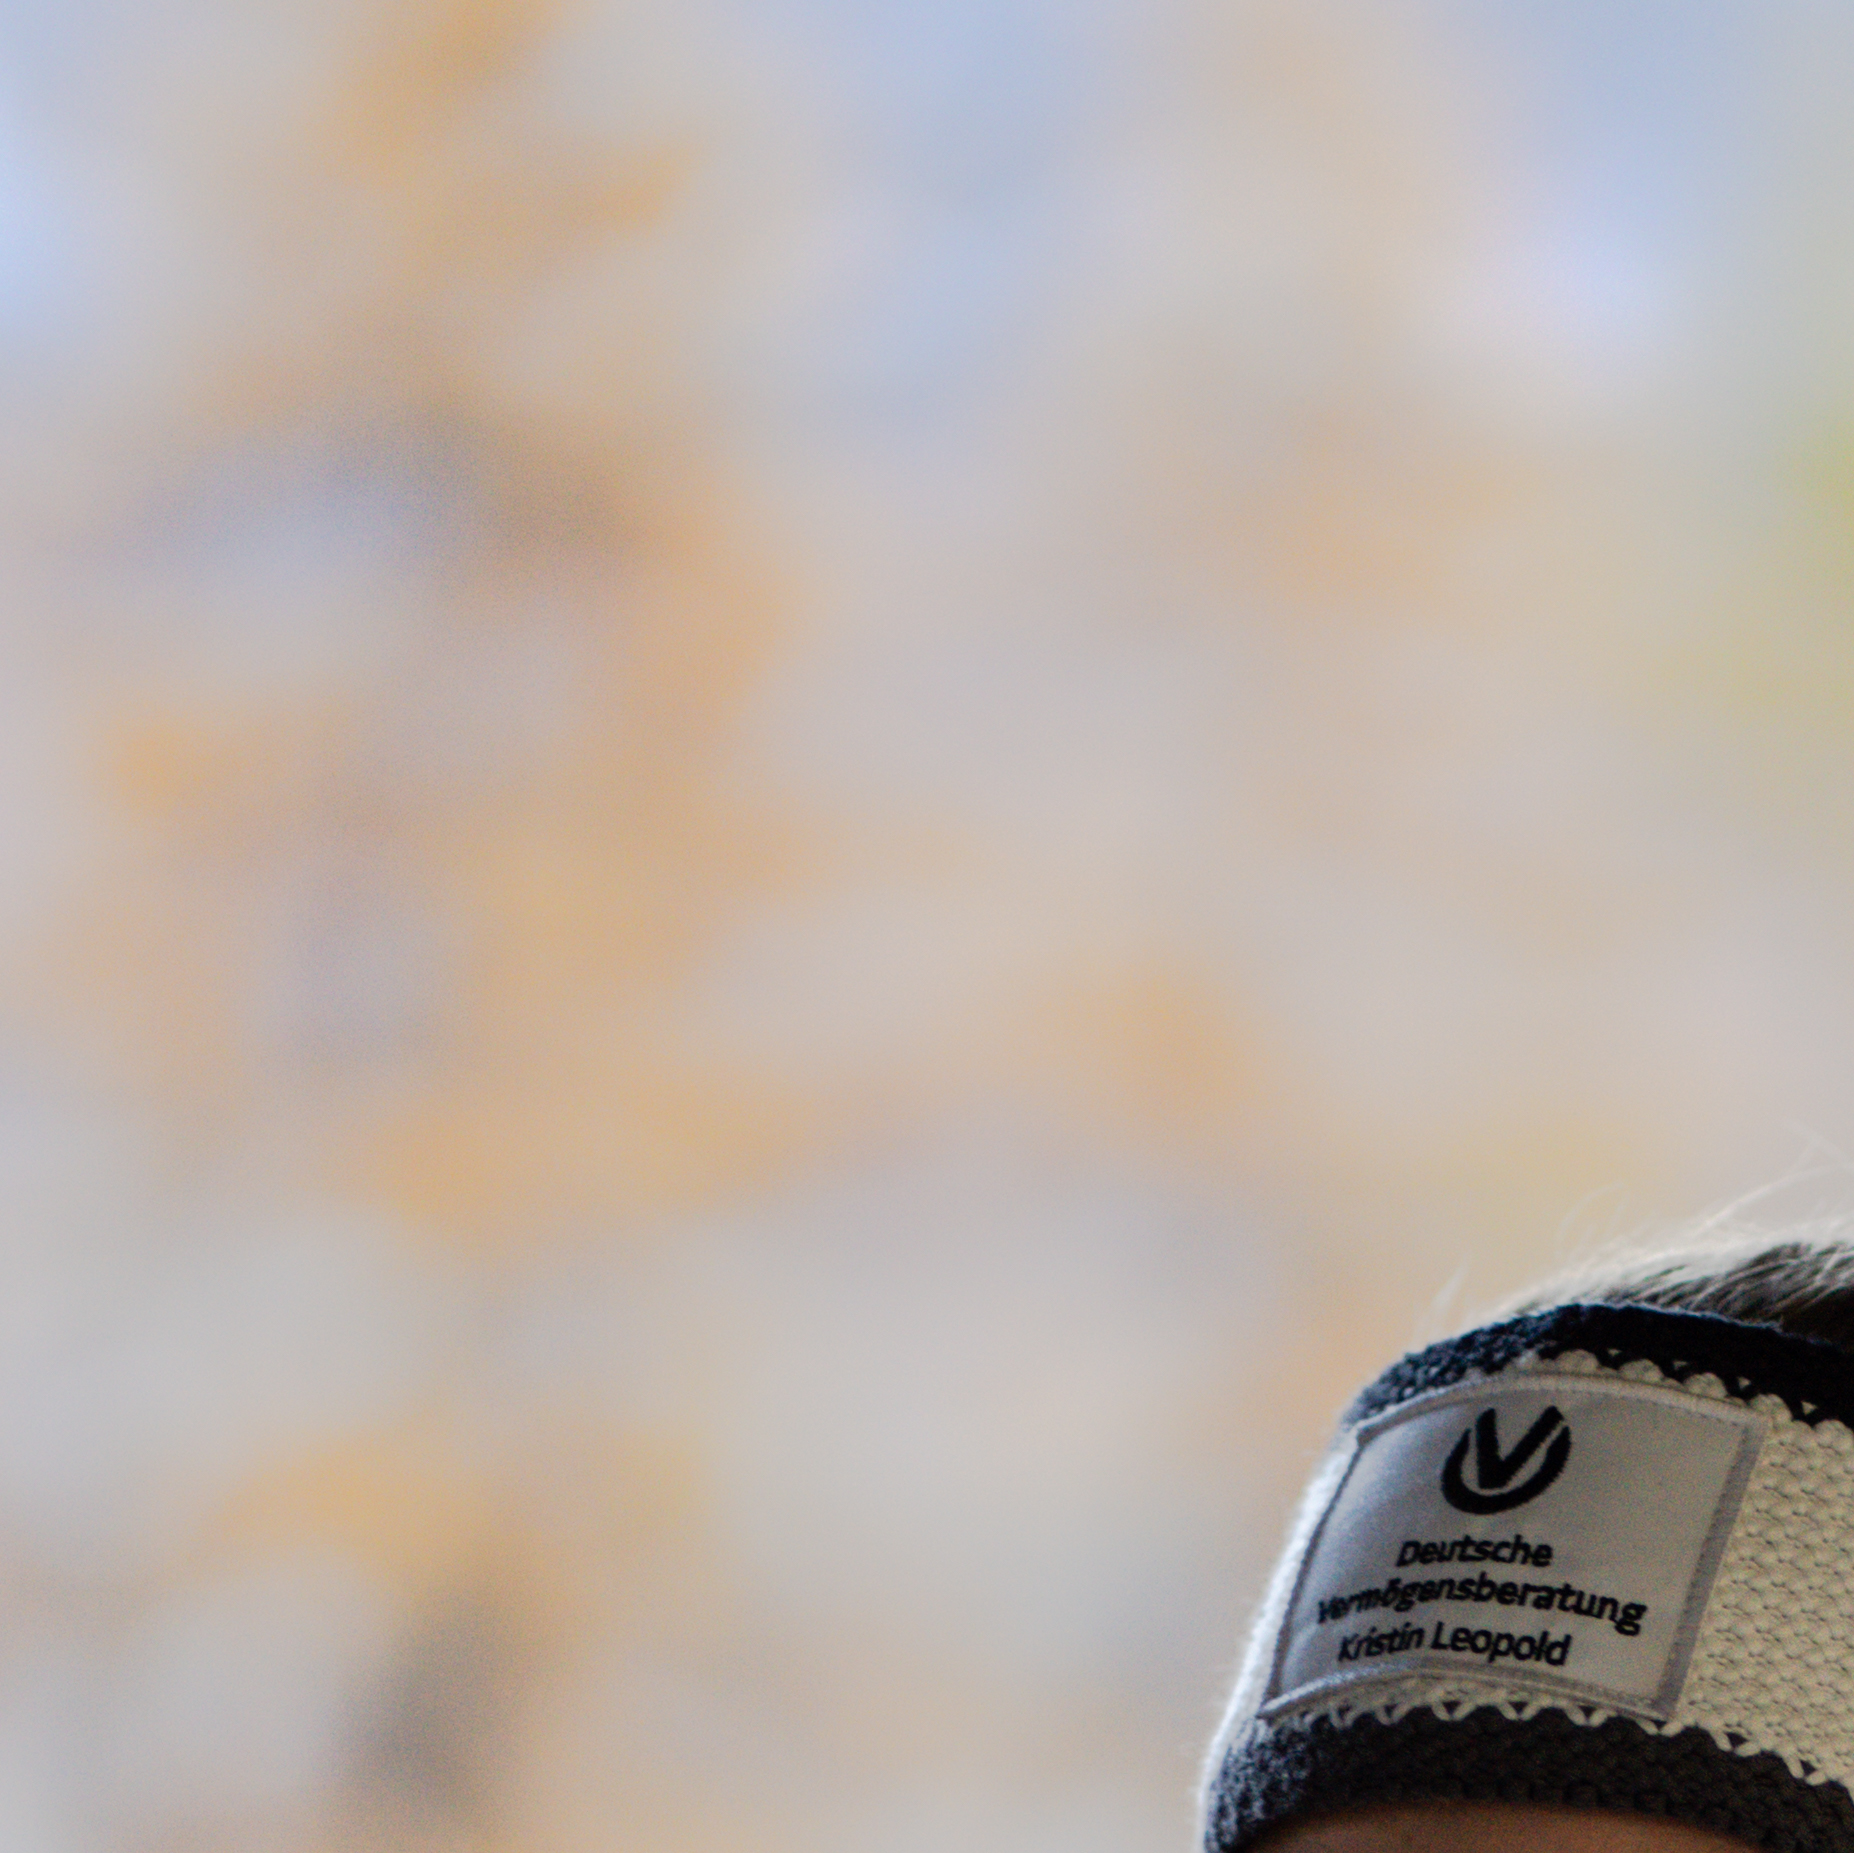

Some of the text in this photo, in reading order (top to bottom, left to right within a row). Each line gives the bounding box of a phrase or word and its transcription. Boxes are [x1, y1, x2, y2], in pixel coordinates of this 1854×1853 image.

[1395, 1533, 1554, 1569] Deutsche
[1318, 1571, 1648, 1637] Vermögensberatung
[1337, 1620, 1572, 1667] Kristin Leopold
